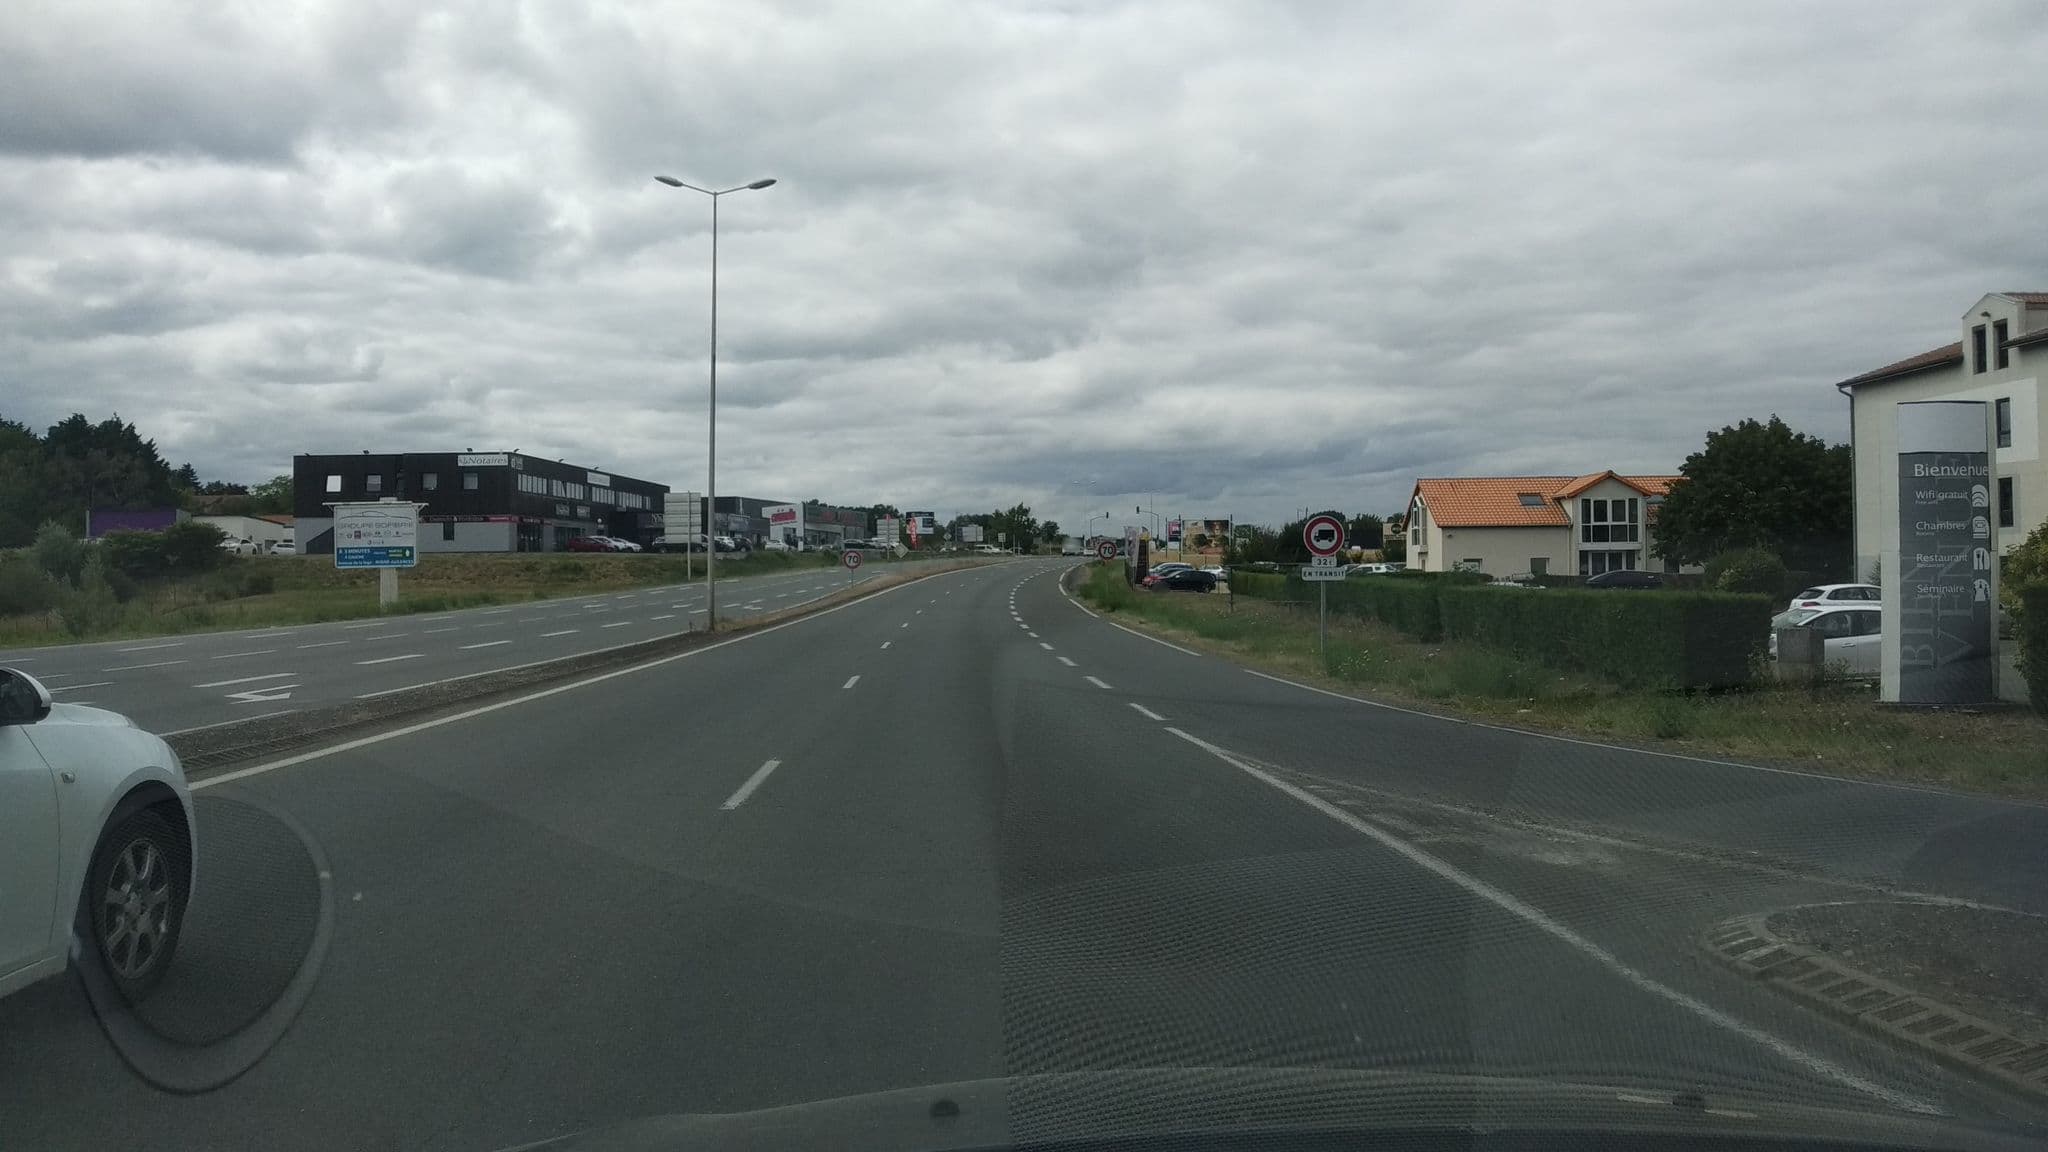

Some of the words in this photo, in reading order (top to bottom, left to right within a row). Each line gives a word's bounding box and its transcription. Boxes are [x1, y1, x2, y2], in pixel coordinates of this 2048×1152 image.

[1914, 463, 1989, 477] Bienvenue
[1915, 490, 1935, 500] Wifi
[1938, 490, 1969, 502] gratuit
[1915, 521, 1966, 530] Chambres
[848, 556, 858, 564] 70
[1916, 553, 1968, 562] Restaurant
